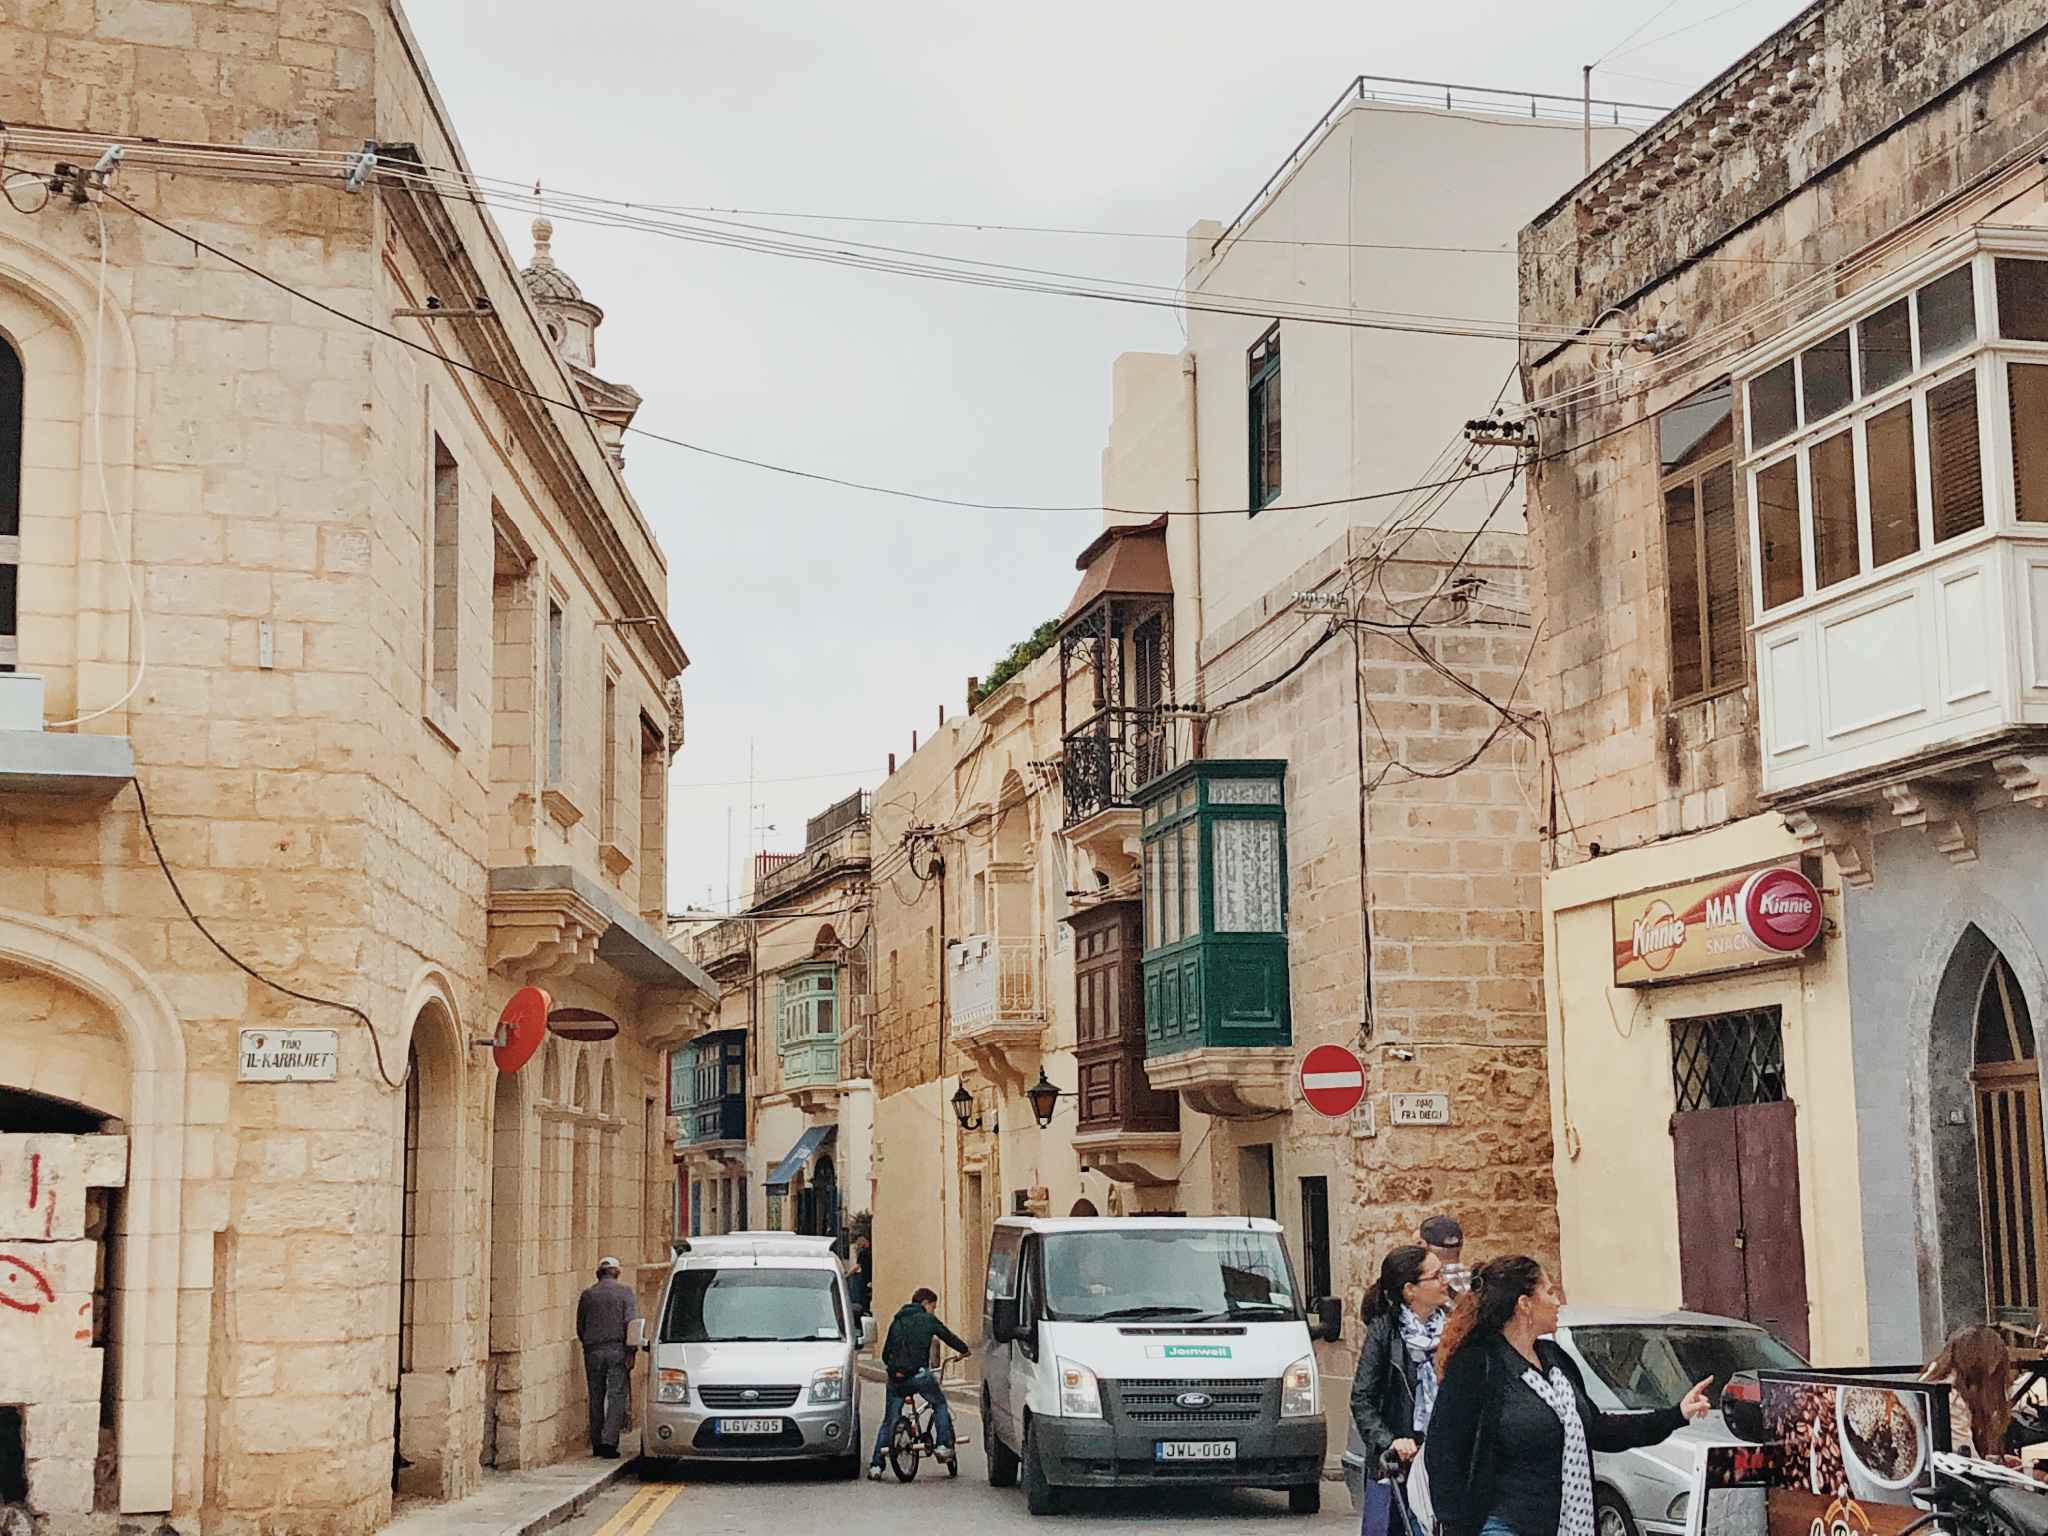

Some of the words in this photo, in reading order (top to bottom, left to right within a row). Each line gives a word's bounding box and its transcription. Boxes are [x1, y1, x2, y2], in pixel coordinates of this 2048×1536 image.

[1758, 893, 1813, 915] Kinnie
[1632, 917, 1686, 957] Kinnie
[1401, 1110, 1417, 1120] FRA
